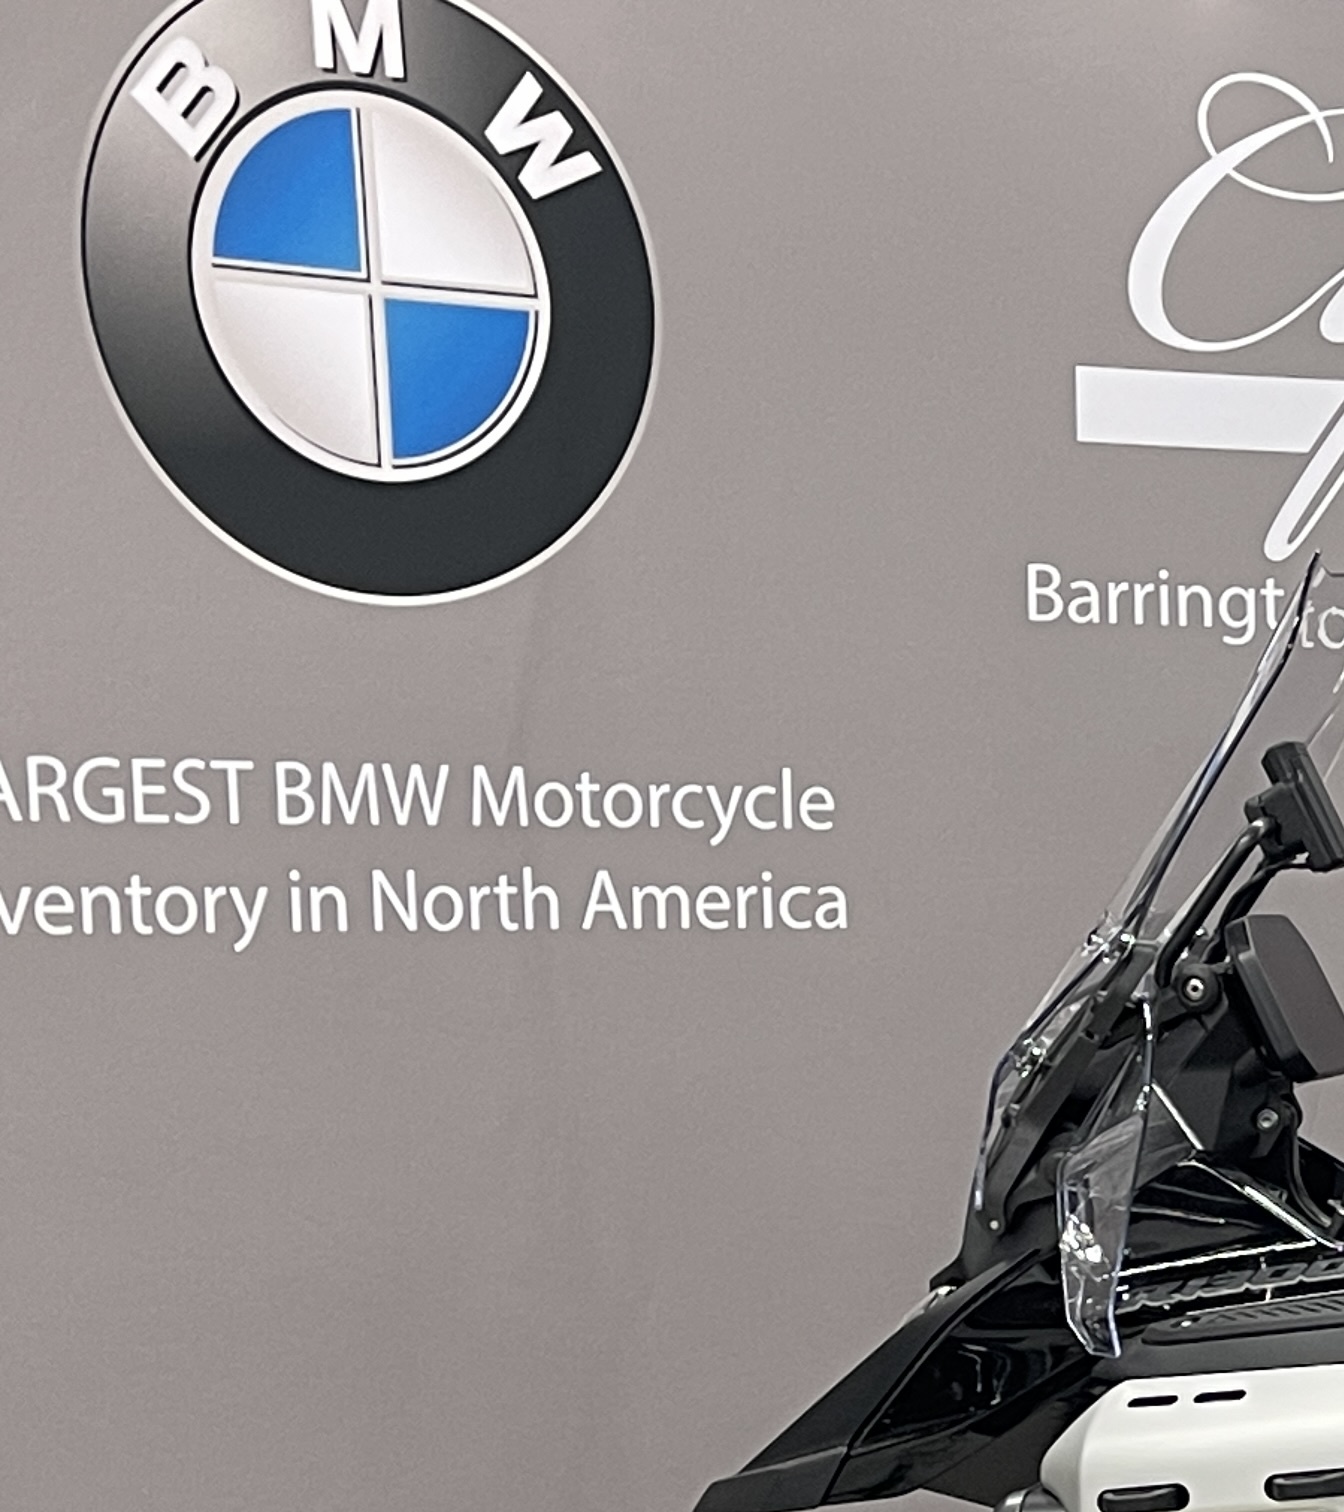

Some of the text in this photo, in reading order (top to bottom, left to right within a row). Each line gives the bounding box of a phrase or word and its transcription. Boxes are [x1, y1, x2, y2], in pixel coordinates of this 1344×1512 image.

[130, 0, 604, 200] BMW
[275, 761, 449, 826] BMW
[472, 764, 835, 846] Motorcycle
[289, 869, 348, 933] in
[371, 866, 560, 932] North
[582, 870, 848, 930] America
